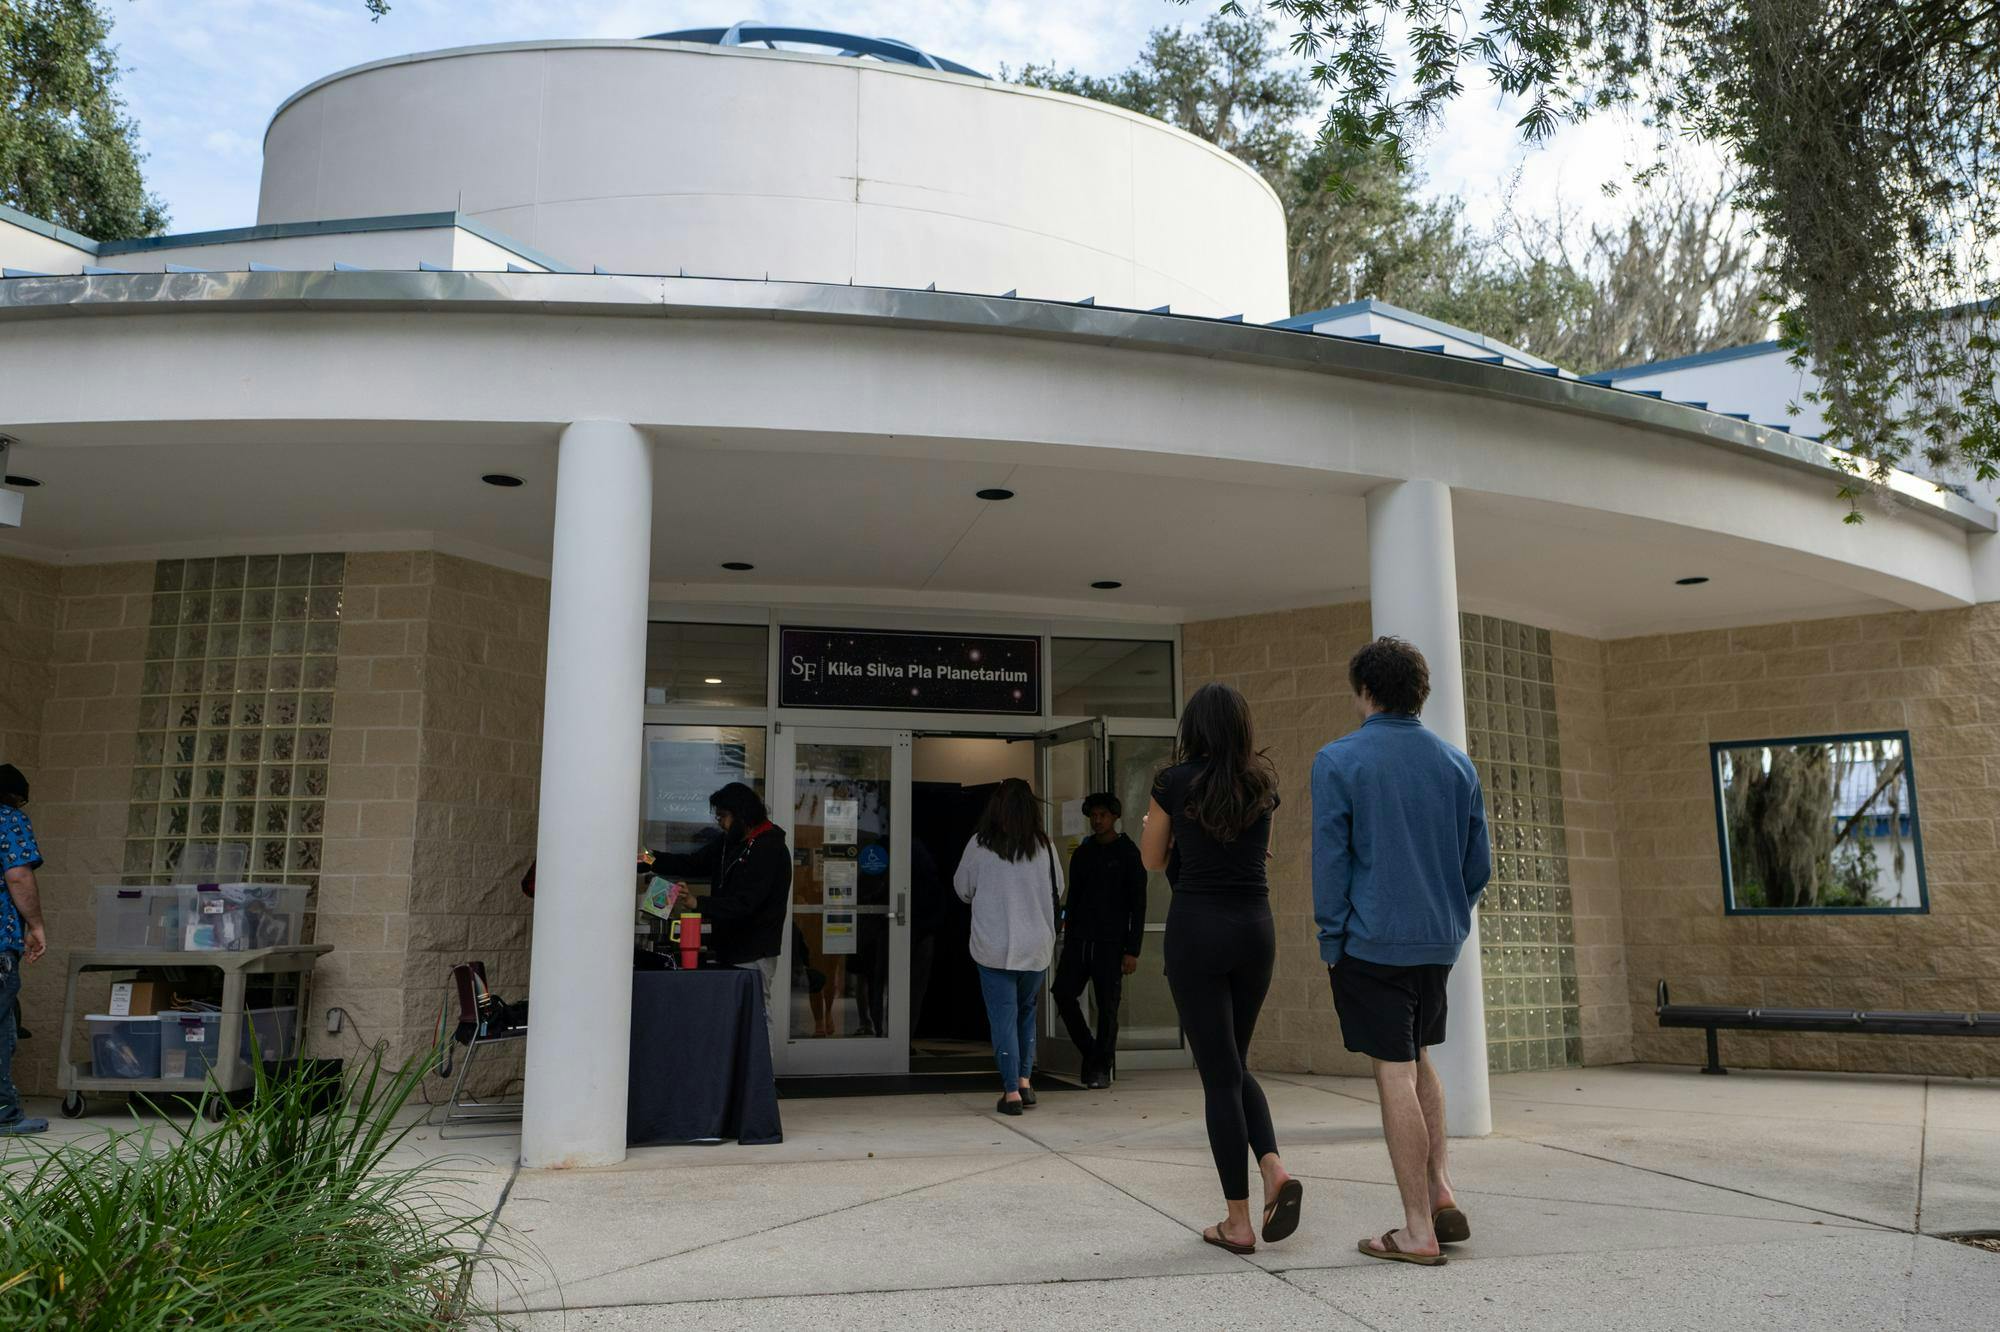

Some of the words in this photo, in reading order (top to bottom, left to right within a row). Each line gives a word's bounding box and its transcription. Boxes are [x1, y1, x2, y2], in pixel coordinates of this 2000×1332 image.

[791, 655, 816, 681] SF
[828, 661, 862, 677] Kika
[866, 663, 903, 678] Silva
[908, 664, 932, 679] Pla
[937, 665, 1028, 682] Planetarium
